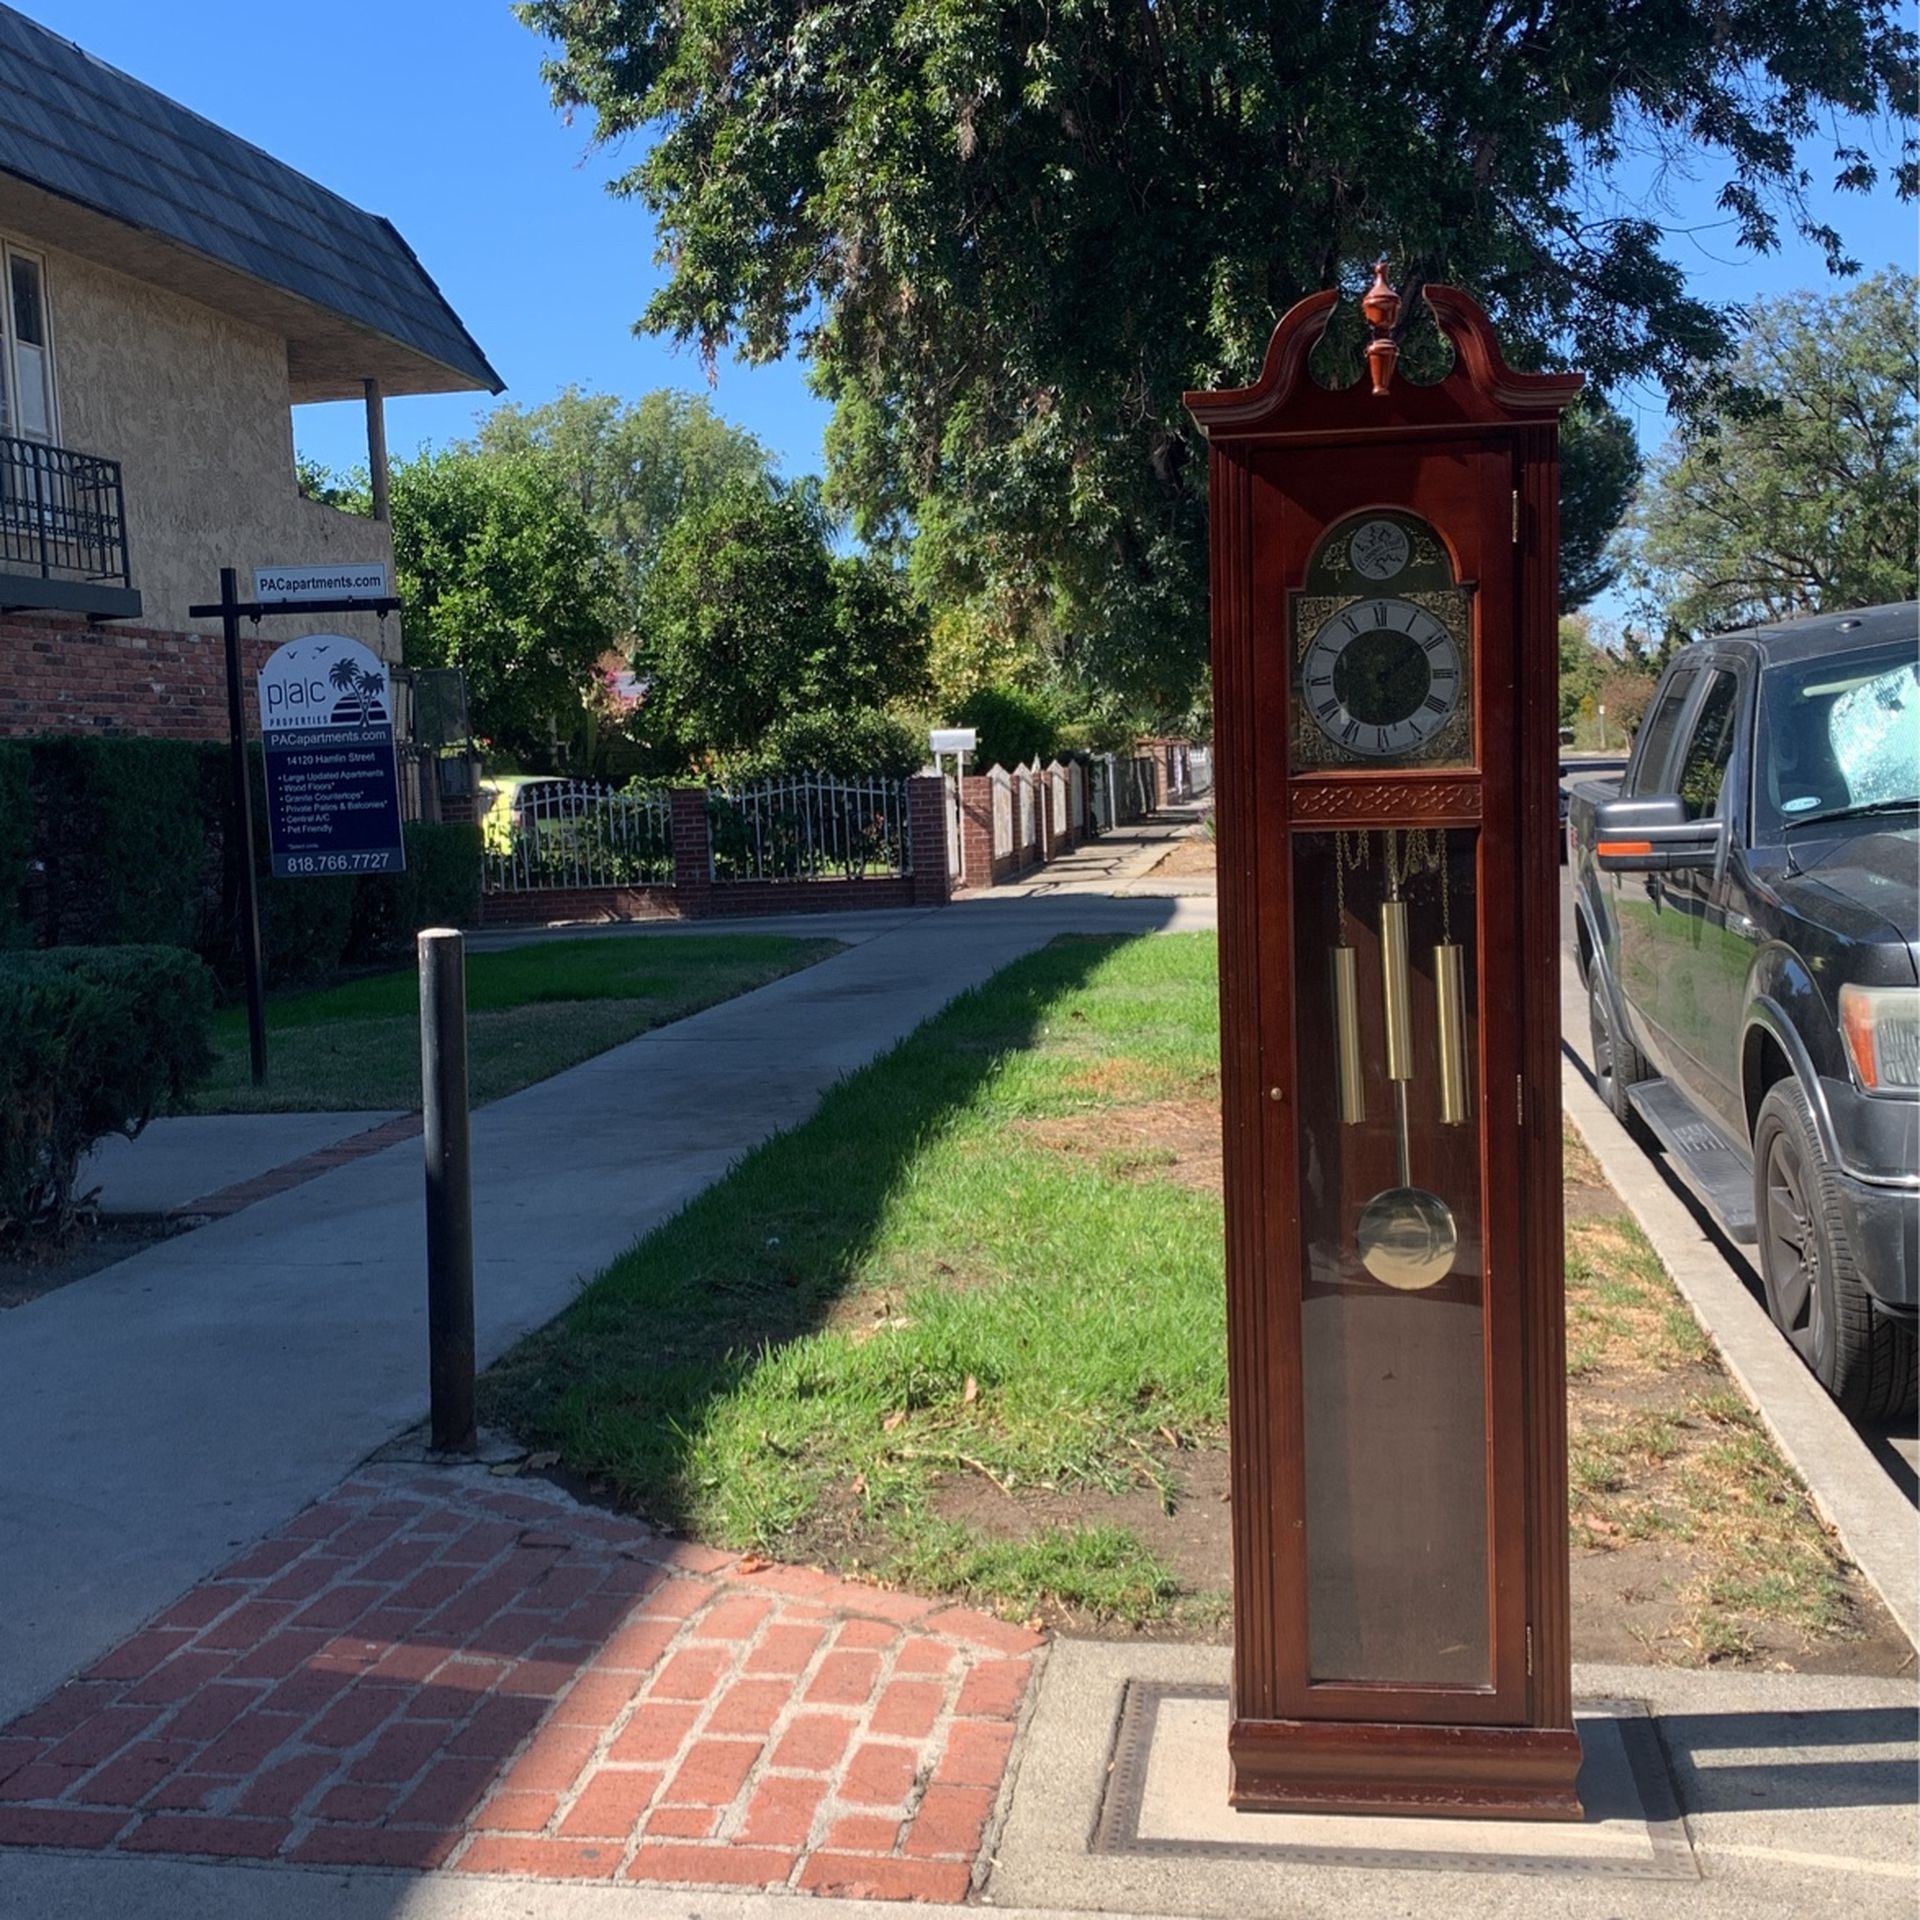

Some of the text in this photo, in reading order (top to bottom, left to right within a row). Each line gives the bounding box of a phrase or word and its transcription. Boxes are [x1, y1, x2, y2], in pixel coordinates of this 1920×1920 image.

[260, 576, 381, 592] PACapartments.com
[1373, 607, 1387, 627] XII
[1405, 613, 1417, 632] I
[269, 715, 328, 727] PROPERTIES
[271, 730, 386, 746] PACapartments.com
[287, 752, 375, 765] 14120 Hamlin Street
[283, 769, 384, 782] Large Updated Apartments
[283, 784, 306, 792] Wood
[285, 794, 313, 803] Granite
[286, 804, 312, 813] Private
[314, 803, 338, 812] Patios
[339, 802, 346, 810] &
[286, 813, 330, 823] Central A/C
[287, 824, 333, 834] Pet Friendly
[287, 853, 389, 873] 818.766.7727
